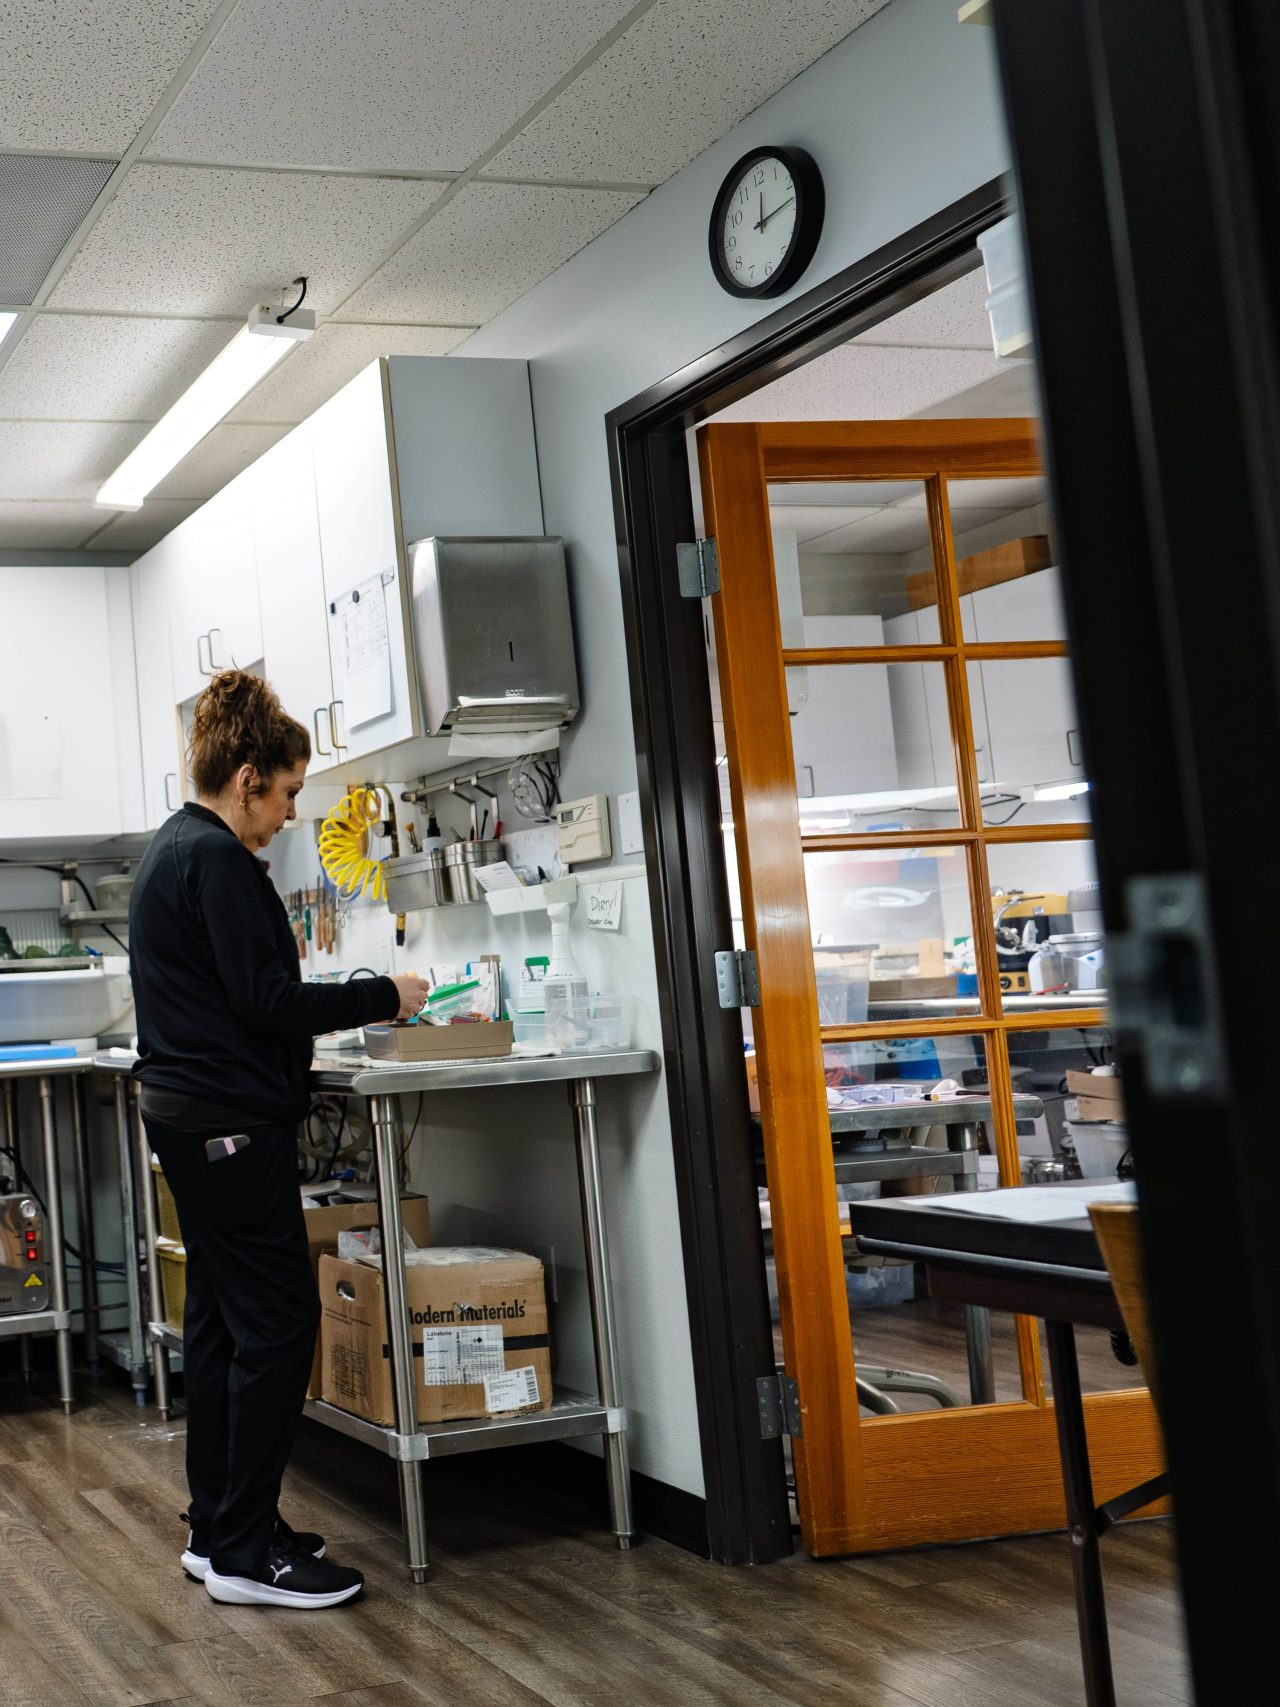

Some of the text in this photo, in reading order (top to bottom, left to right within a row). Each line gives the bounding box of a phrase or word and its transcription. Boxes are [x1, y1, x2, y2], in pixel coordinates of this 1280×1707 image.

[753, 169, 765, 188] 12
[772, 167, 778, 181] 1
[785, 175, 793, 191] 2
[738, 187, 750, 205] 11
[730, 210, 743, 229] 10
[728, 236, 737, 252] 9
[735, 255, 743, 271] 8
[764, 261, 773, 277] 6
[748, 264, 756, 280] 7
[460, 1299, 526, 1322] Materials
